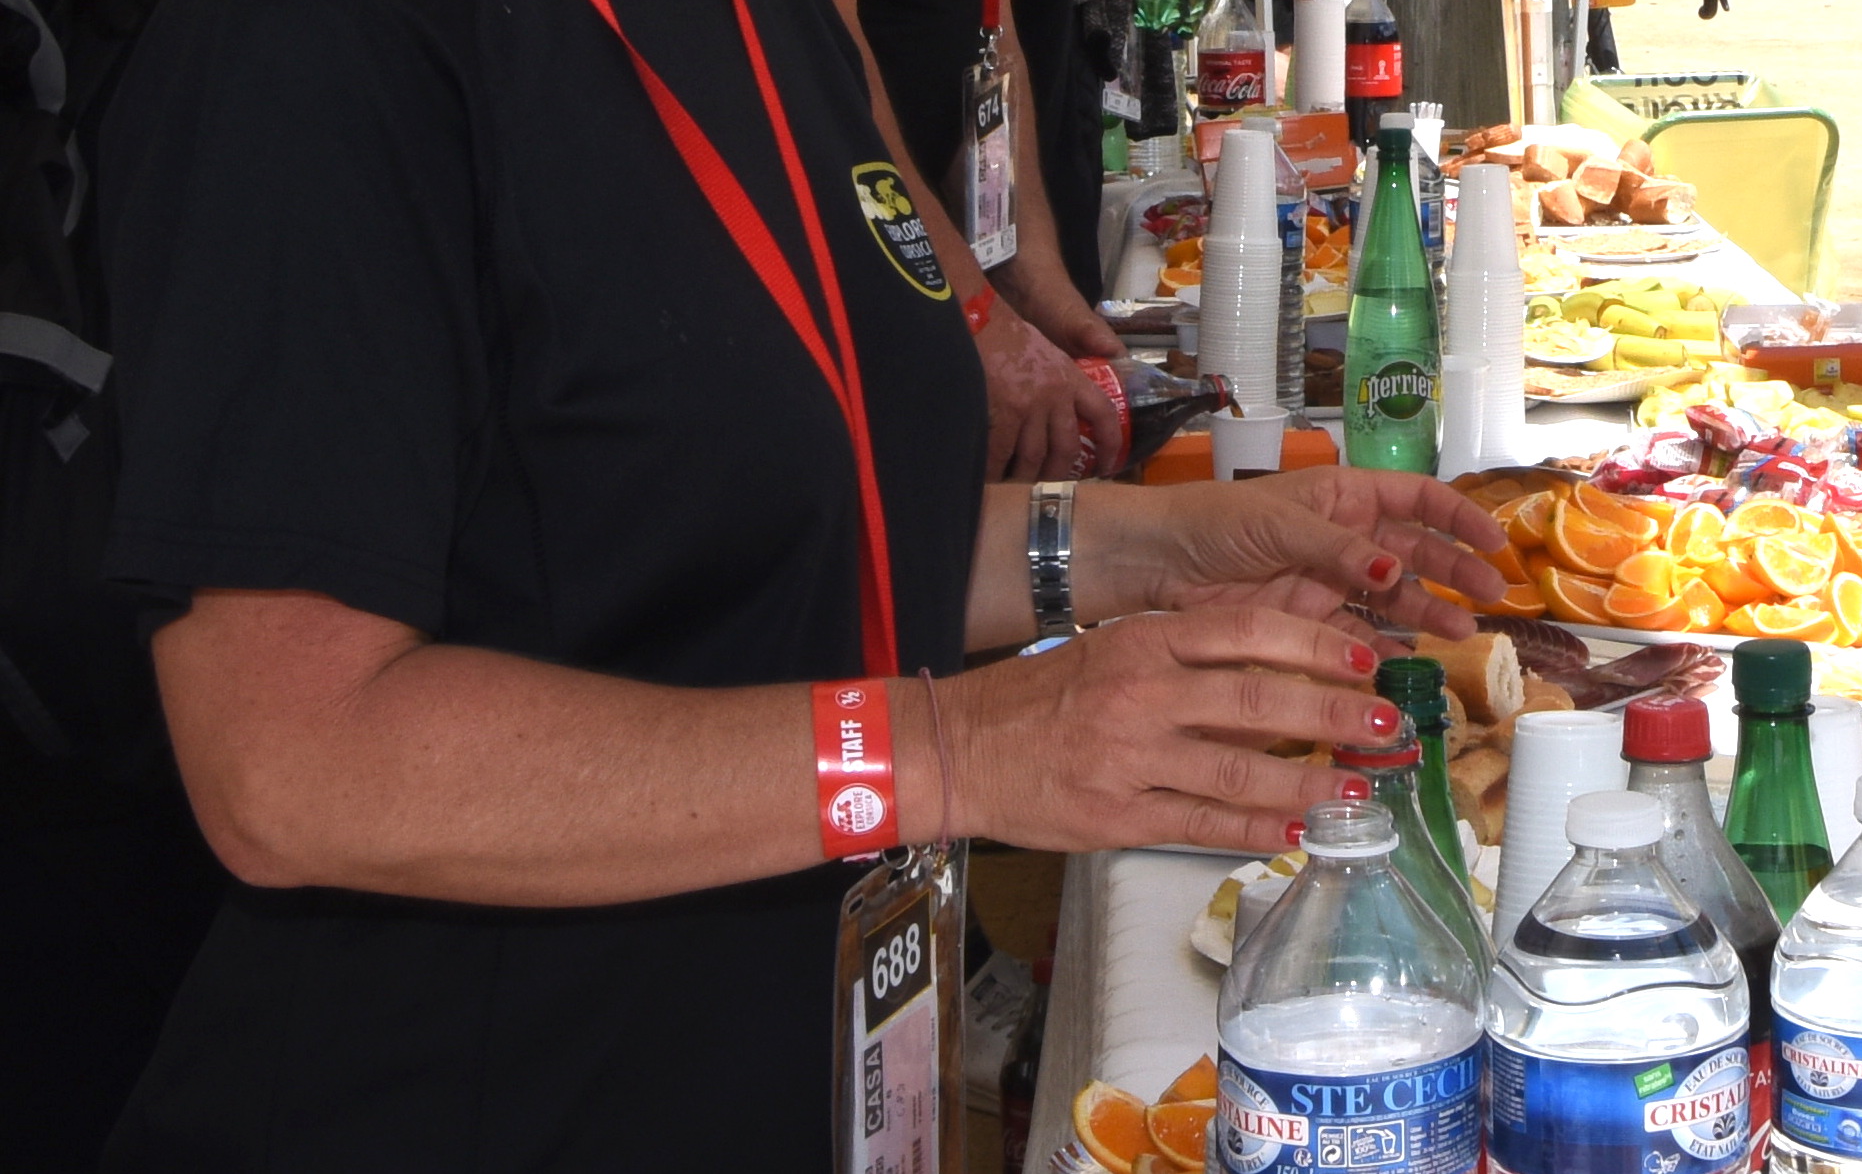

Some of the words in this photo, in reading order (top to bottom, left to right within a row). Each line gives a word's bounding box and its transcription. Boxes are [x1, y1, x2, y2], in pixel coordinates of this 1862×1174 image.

[977, 93, 1000, 128] 674
[840, 718, 865, 773] STAFF
[872, 922, 921, 1000] 688
[866, 1047, 882, 1131] CASA
[1290, 1082, 1373, 1117] STE
